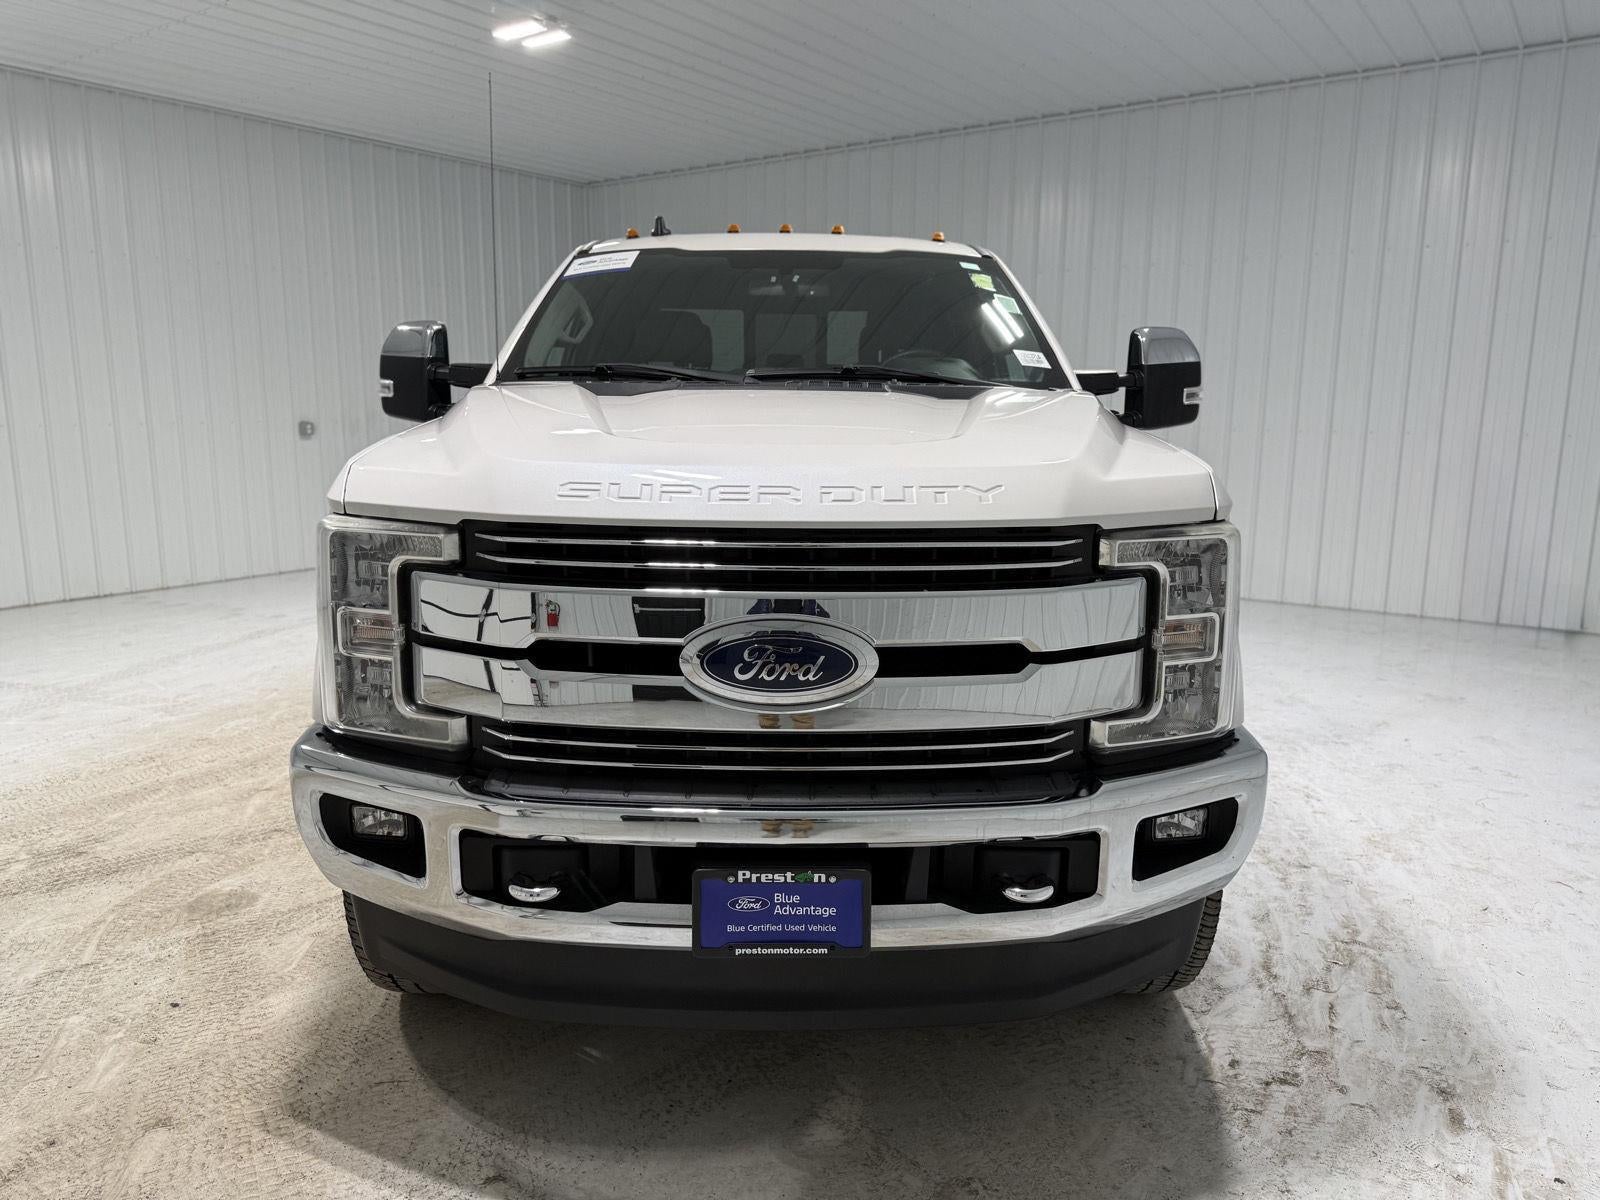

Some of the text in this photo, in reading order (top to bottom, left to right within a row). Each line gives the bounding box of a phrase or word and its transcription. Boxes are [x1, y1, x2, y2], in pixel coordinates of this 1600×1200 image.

[557, 481, 1005, 505] SUPER DUTY
[733, 644, 826, 681] Ford
[737, 870, 826, 883] Prestn
[735, 898, 763, 910] Ford
[774, 893, 800, 903] Blue
[774, 905, 837, 917] Advantage
[727, 924, 837, 932] Blue Certified Used Vehicle
[735, 946, 828, 956] prestonmotor.com
